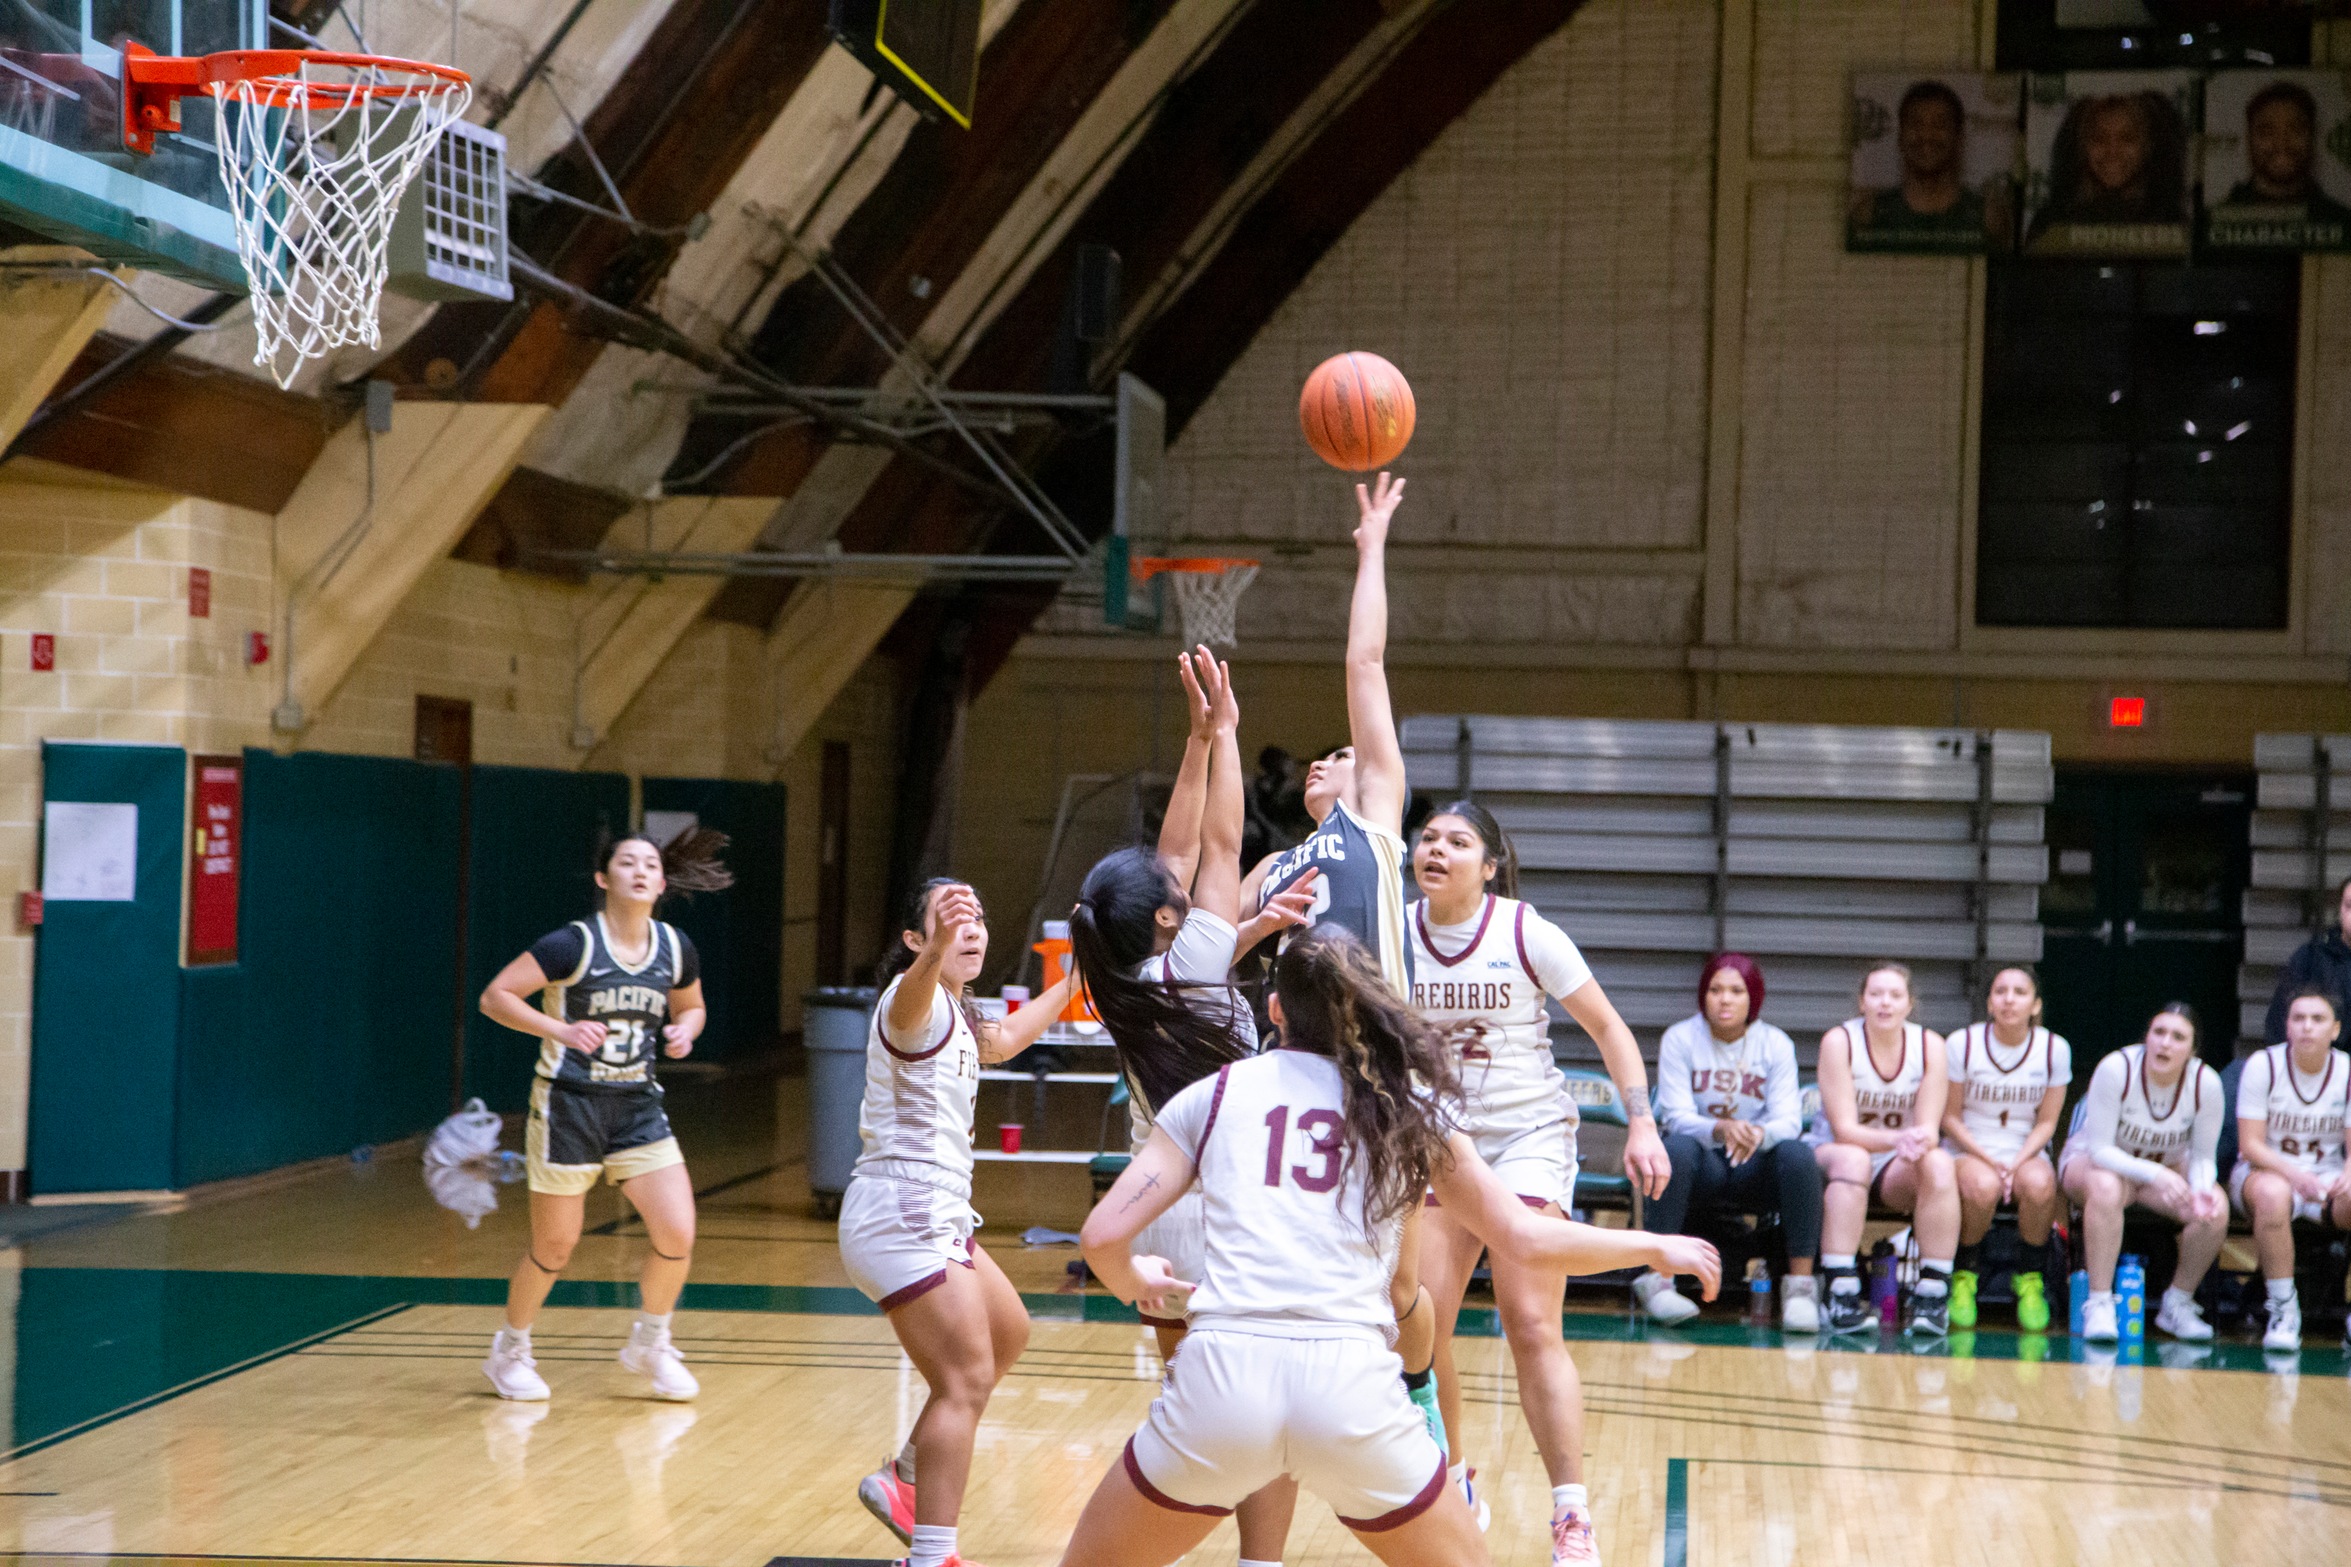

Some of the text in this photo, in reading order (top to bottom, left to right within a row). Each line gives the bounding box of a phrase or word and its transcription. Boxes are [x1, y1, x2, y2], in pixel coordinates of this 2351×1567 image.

[602, 1020, 645, 1062] 21
[1692, 1070, 1767, 1101] USK
[1263, 1104, 1345, 1194] 13
